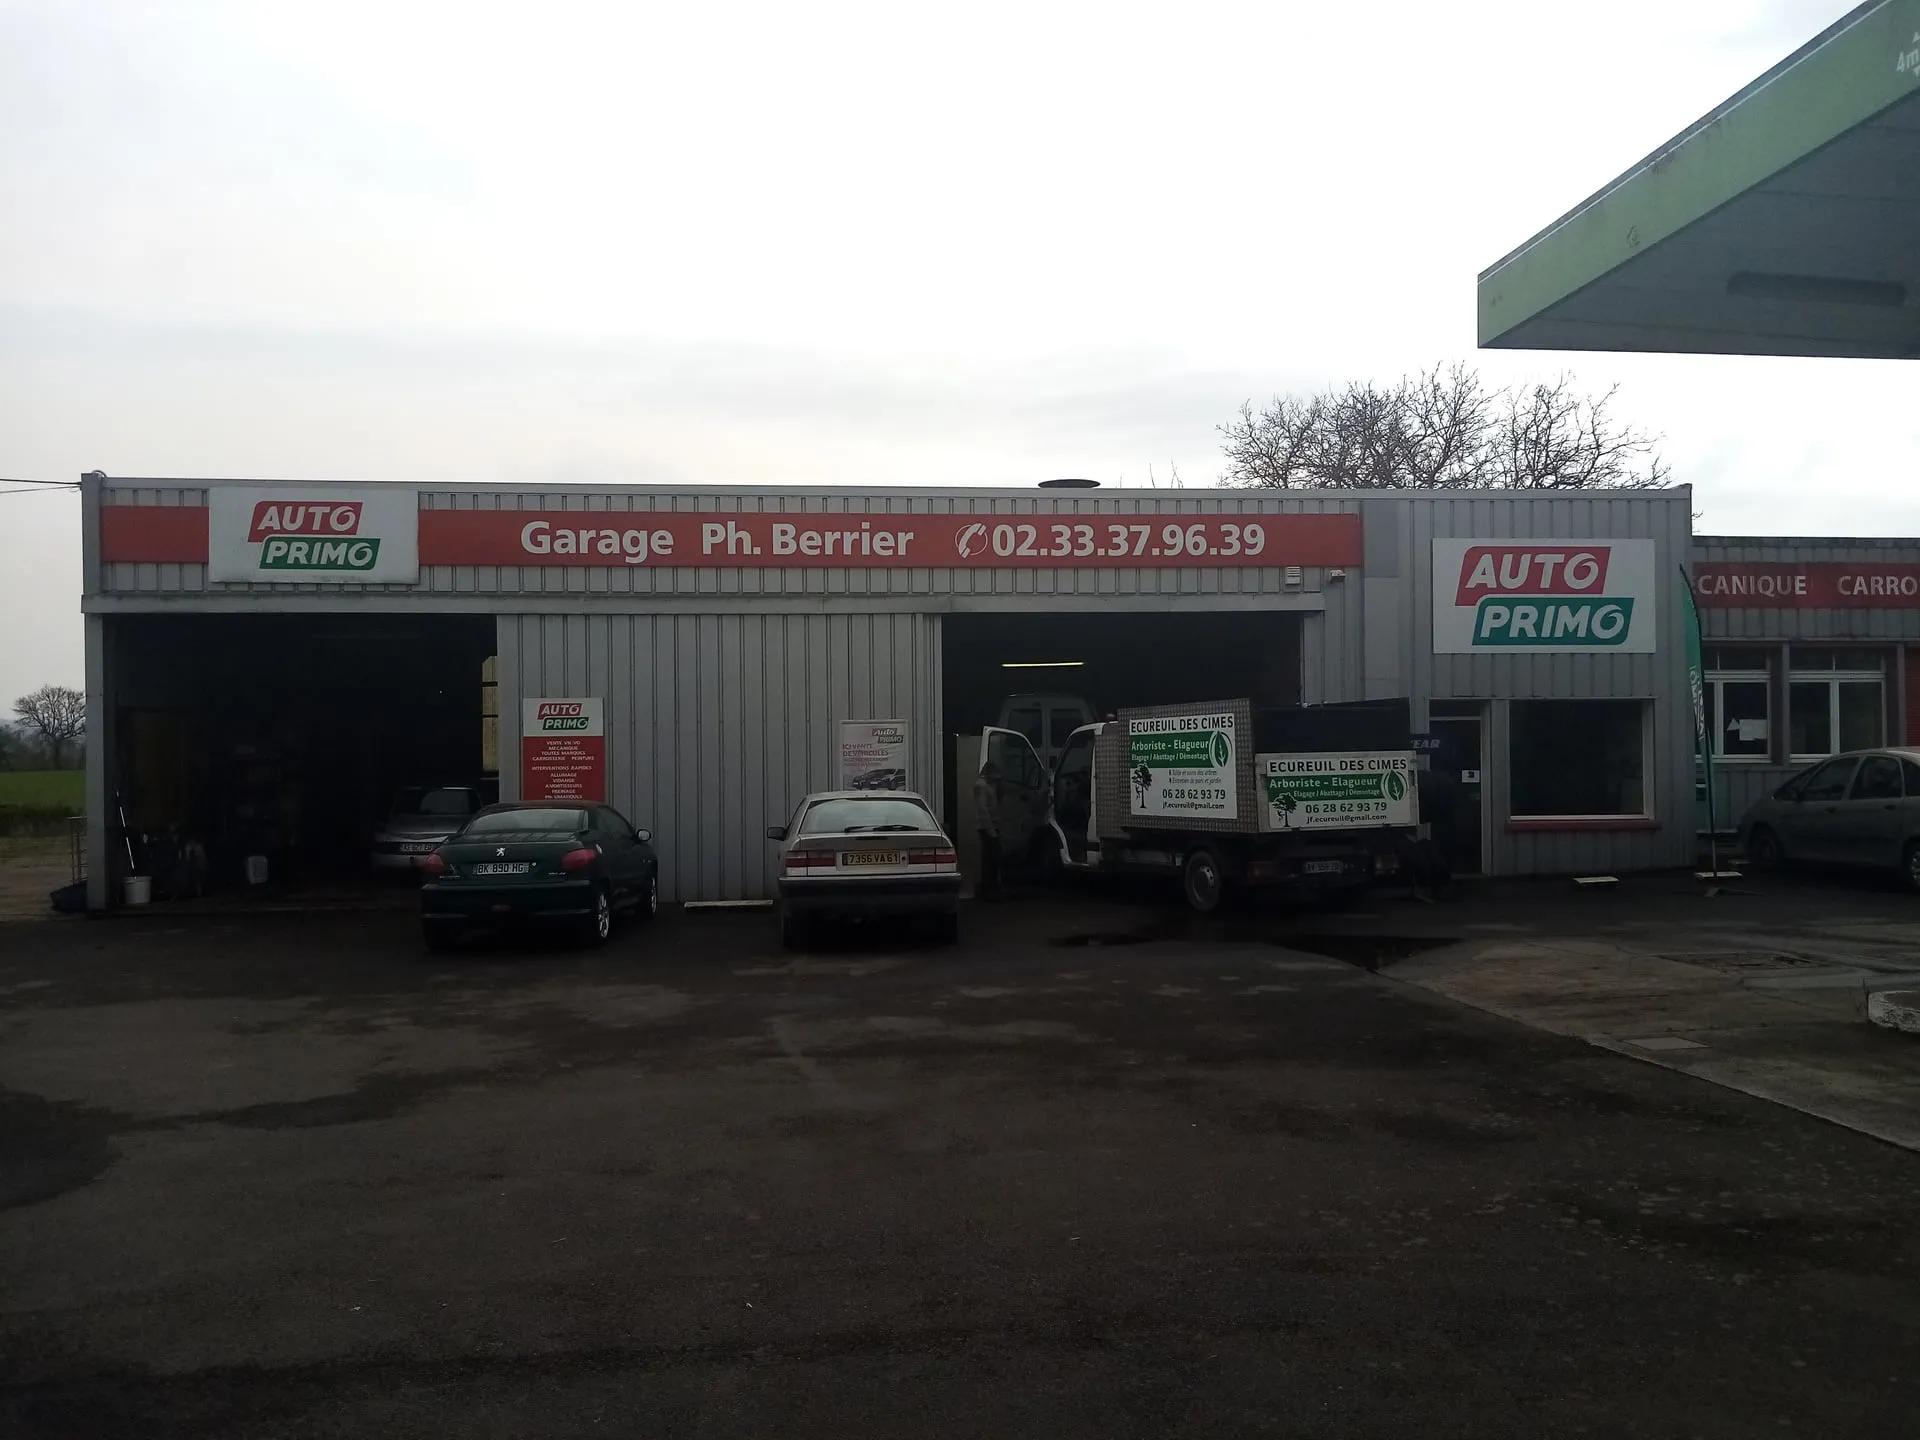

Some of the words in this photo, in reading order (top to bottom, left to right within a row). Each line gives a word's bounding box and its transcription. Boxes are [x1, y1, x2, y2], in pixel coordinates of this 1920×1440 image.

[257, 505, 356, 531] AUTO
[520, 520, 674, 564] Garage
[702, 521, 761, 556] Ph.
[772, 522, 913, 556] Berrier
[992, 524, 1265, 557] 02.33.37.96.39
[265, 541, 373, 566] PRIMO
[1464, 553, 1599, 590] AUTO
[1837, 575, 1920, 596] CARRO
[1480, 604, 1625, 639] PRIMO
[541, 704, 580, 715] AUTO
[545, 718, 588, 729] PRIMO
[1131, 720, 1176, 733] ECUREUIL
[1180, 718, 1198, 730] DES
[1201, 716, 1233, 729] CIMES
[1131, 740, 1166, 751] Arboriste
[1173, 740, 1209, 752] Elagueur
[1411, 739, 1440, 748] EAR
[1270, 761, 1336, 773] ECUREUIL
[1340, 760, 1364, 771] DES
[1368, 759, 1406, 770] CIMES
[1269, 778, 1320, 788] Arboriste
[1332, 777, 1377, 789] Elagueur
[1162, 789, 1172, 799] 06
[1175, 789, 1185, 799] 28
[1187, 789, 1198, 800] 62
[1200, 789, 1211, 800] 93
[1214, 789, 1226, 800] 79
[1305, 804, 1319, 813] 06
[1323, 804, 1337, 813] 28
[1340, 803, 1354, 813] 62
[1357, 803, 1371, 812] 93
[1374, 802, 1387, 811] 79
[1307, 814, 1387, 824] jf.ecureuil@gmail.com
[874, 854, 885, 862] VA
[887, 853, 898, 862] 61
[478, 863, 489, 873] BK
[492, 863, 508, 872] 890
[512, 863, 523, 872] HG
